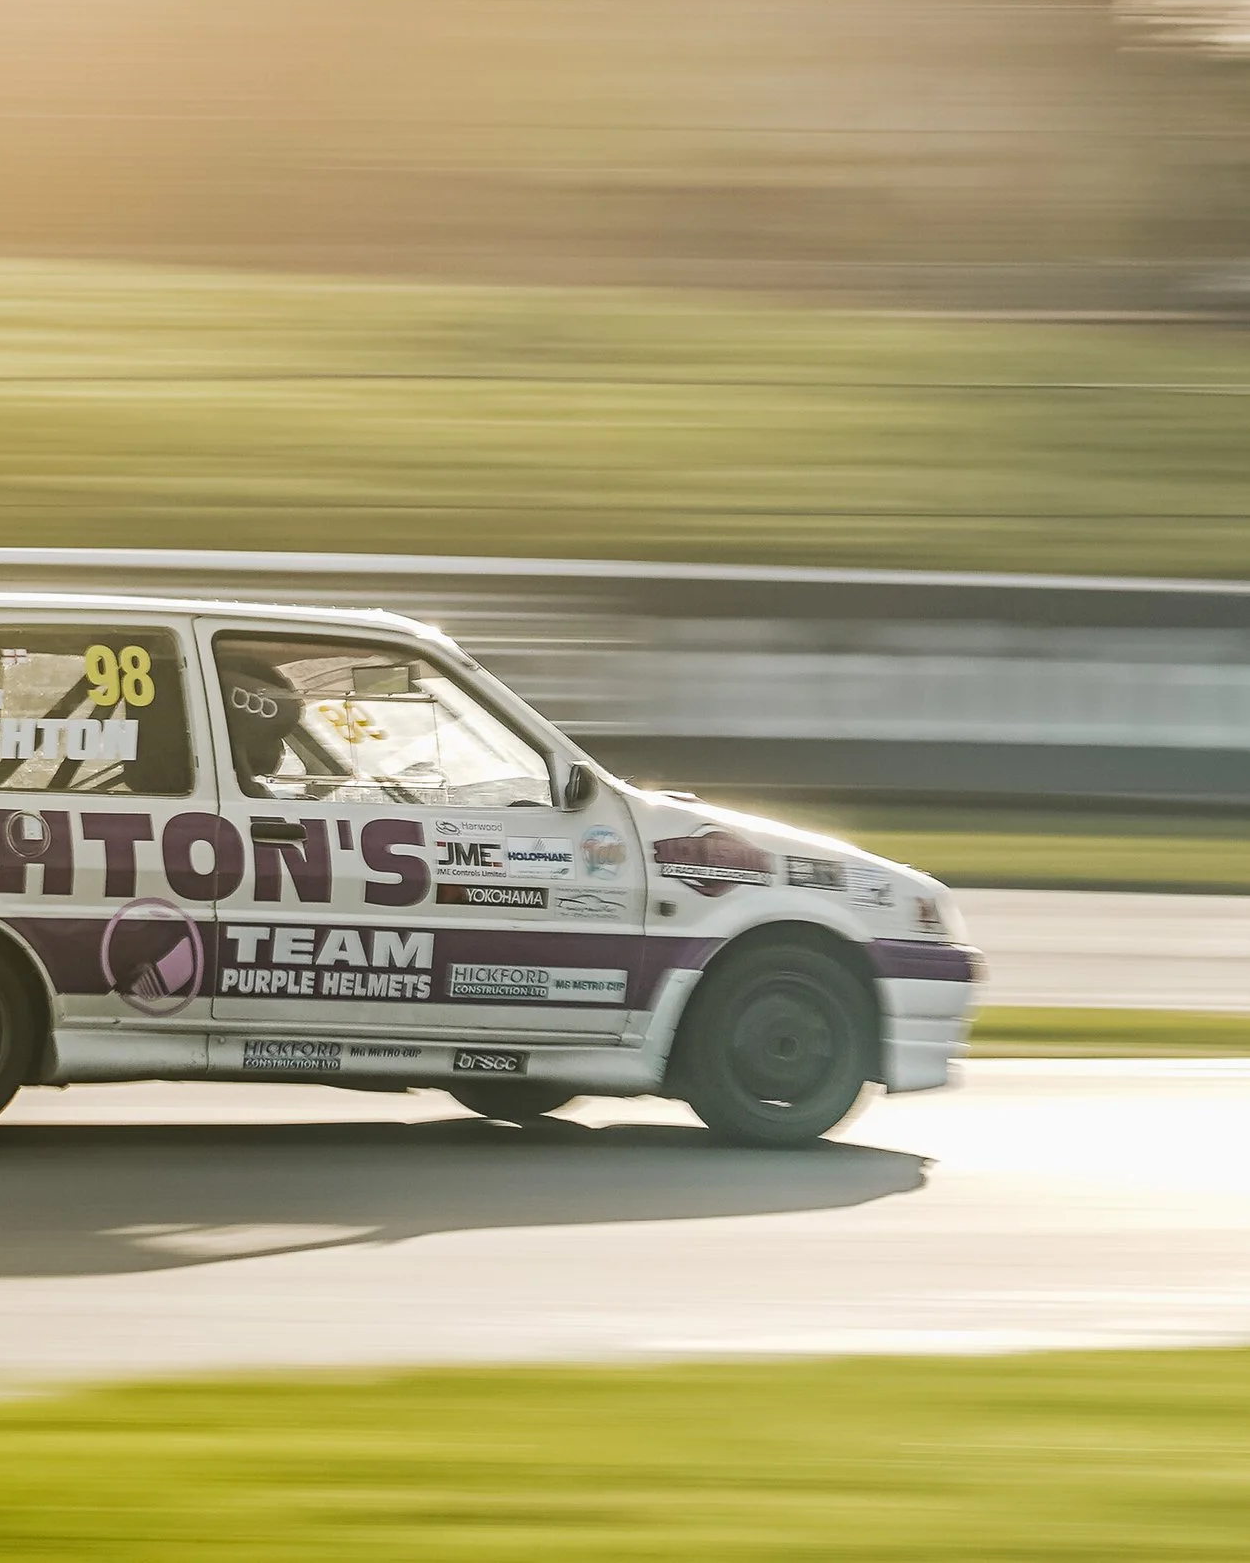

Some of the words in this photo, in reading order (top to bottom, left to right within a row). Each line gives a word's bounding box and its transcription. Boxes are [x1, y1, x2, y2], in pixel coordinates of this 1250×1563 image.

[85, 645, 156, 707] 98
[461, 821, 503, 832] Harwood
[437, 841, 502, 868] JME
[507, 851, 573, 863] HOLOPHANE
[452, 869, 481, 877] Controls
[482, 870, 507, 878] Limited
[466, 888, 544, 905] YOKOHAMA
[225, 925, 435, 969] TEAM
[454, 967, 549, 984] HICKFORD
[221, 968, 315, 995] PURPLE
[321, 971, 432, 999] HELMETS
[454, 985, 528, 996] CONSTRUCTION
[530, 987, 547, 996] LTD
[573, 980, 605, 991] METRO
[606, 981, 626, 992] CUP
[244, 1040, 342, 1057] HICKFORD
[368, 1047, 400, 1057] METRO
[402, 1048, 422, 1058] CUP
[245, 1058, 319, 1069] CONSTRUCTION
[322, 1060, 340, 1069] LTD
